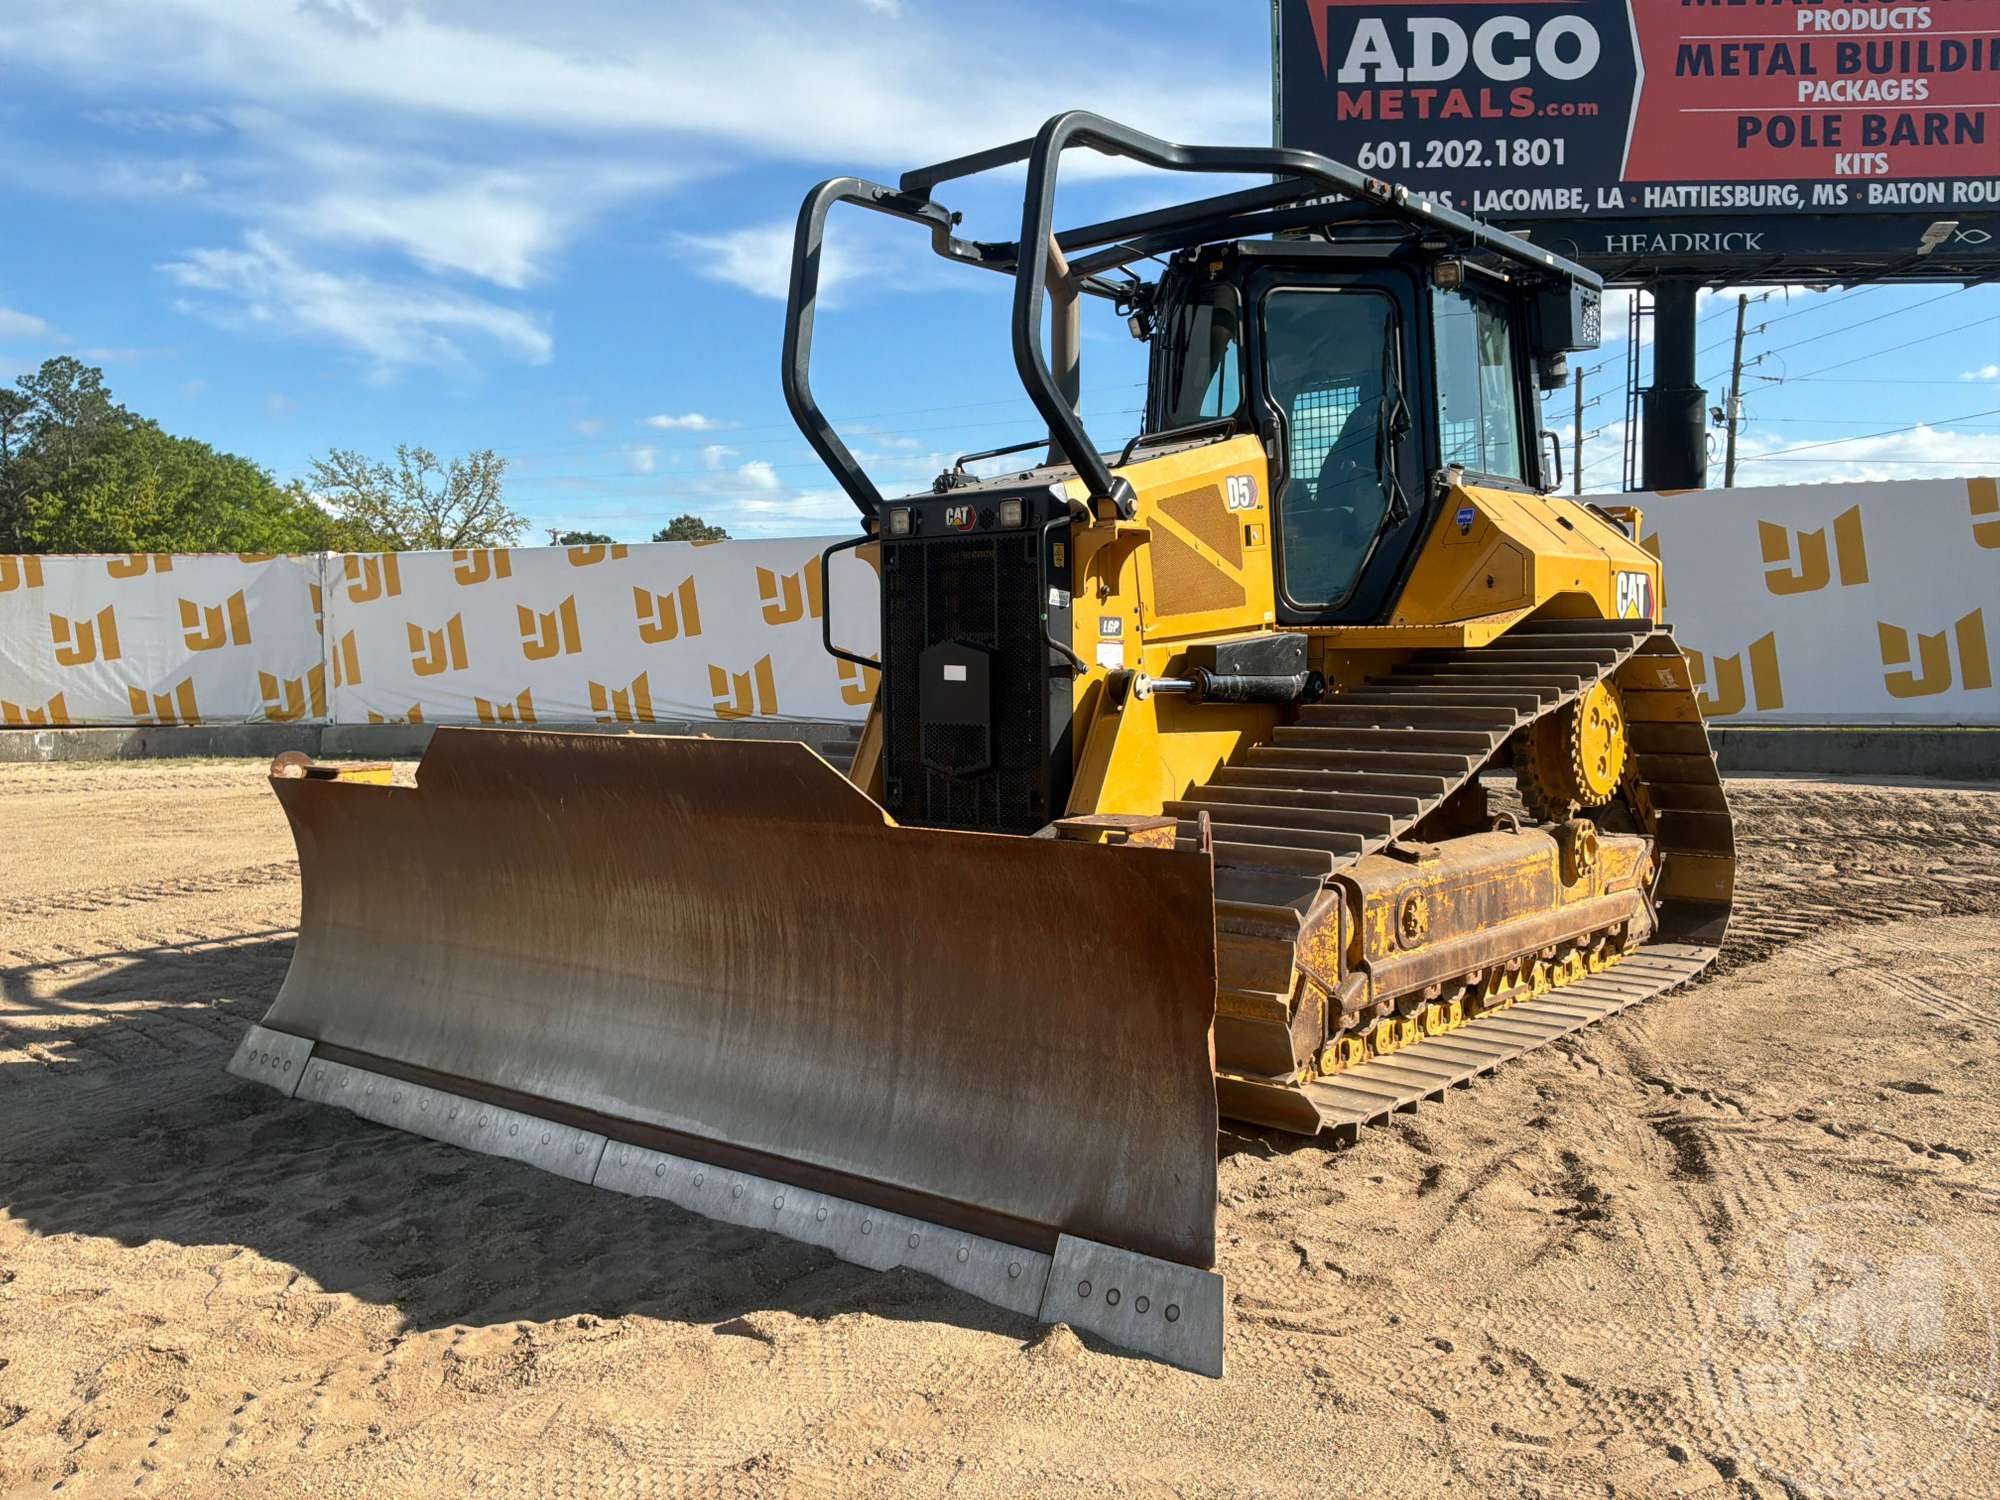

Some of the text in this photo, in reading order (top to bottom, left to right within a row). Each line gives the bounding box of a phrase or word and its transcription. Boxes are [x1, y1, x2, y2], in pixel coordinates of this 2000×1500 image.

[1797, 7, 1932, 31] PRODUCTS
[1337, 15, 1600, 83] ADCO
[1675, 38, 2000, 77] METAL BUILDI
[1337, 87, 1599, 121] METALS.com
[1798, 78, 1928, 102] PACKAGES
[1737, 111, 1985, 148] POLE BARN
[1357, 138, 1565, 169] 601.202.1801
[1835, 152, 1889, 175] KITS
[1473, 187, 1590, 213] LACOMBE,
[1597, 187, 1625, 209] LA
[1644, 184, 1806, 209] HATTIESBURG,
[1813, 183, 1848, 206] MS
[1868, 182, 1946, 204] BATON
[1605, 231, 1767, 253] HEADRICK
[1226, 476, 1250, 508] D5
[946, 506, 969, 527] CAT
[1617, 572, 1647, 619] CAT
[1102, 620, 1120, 633] LGP
